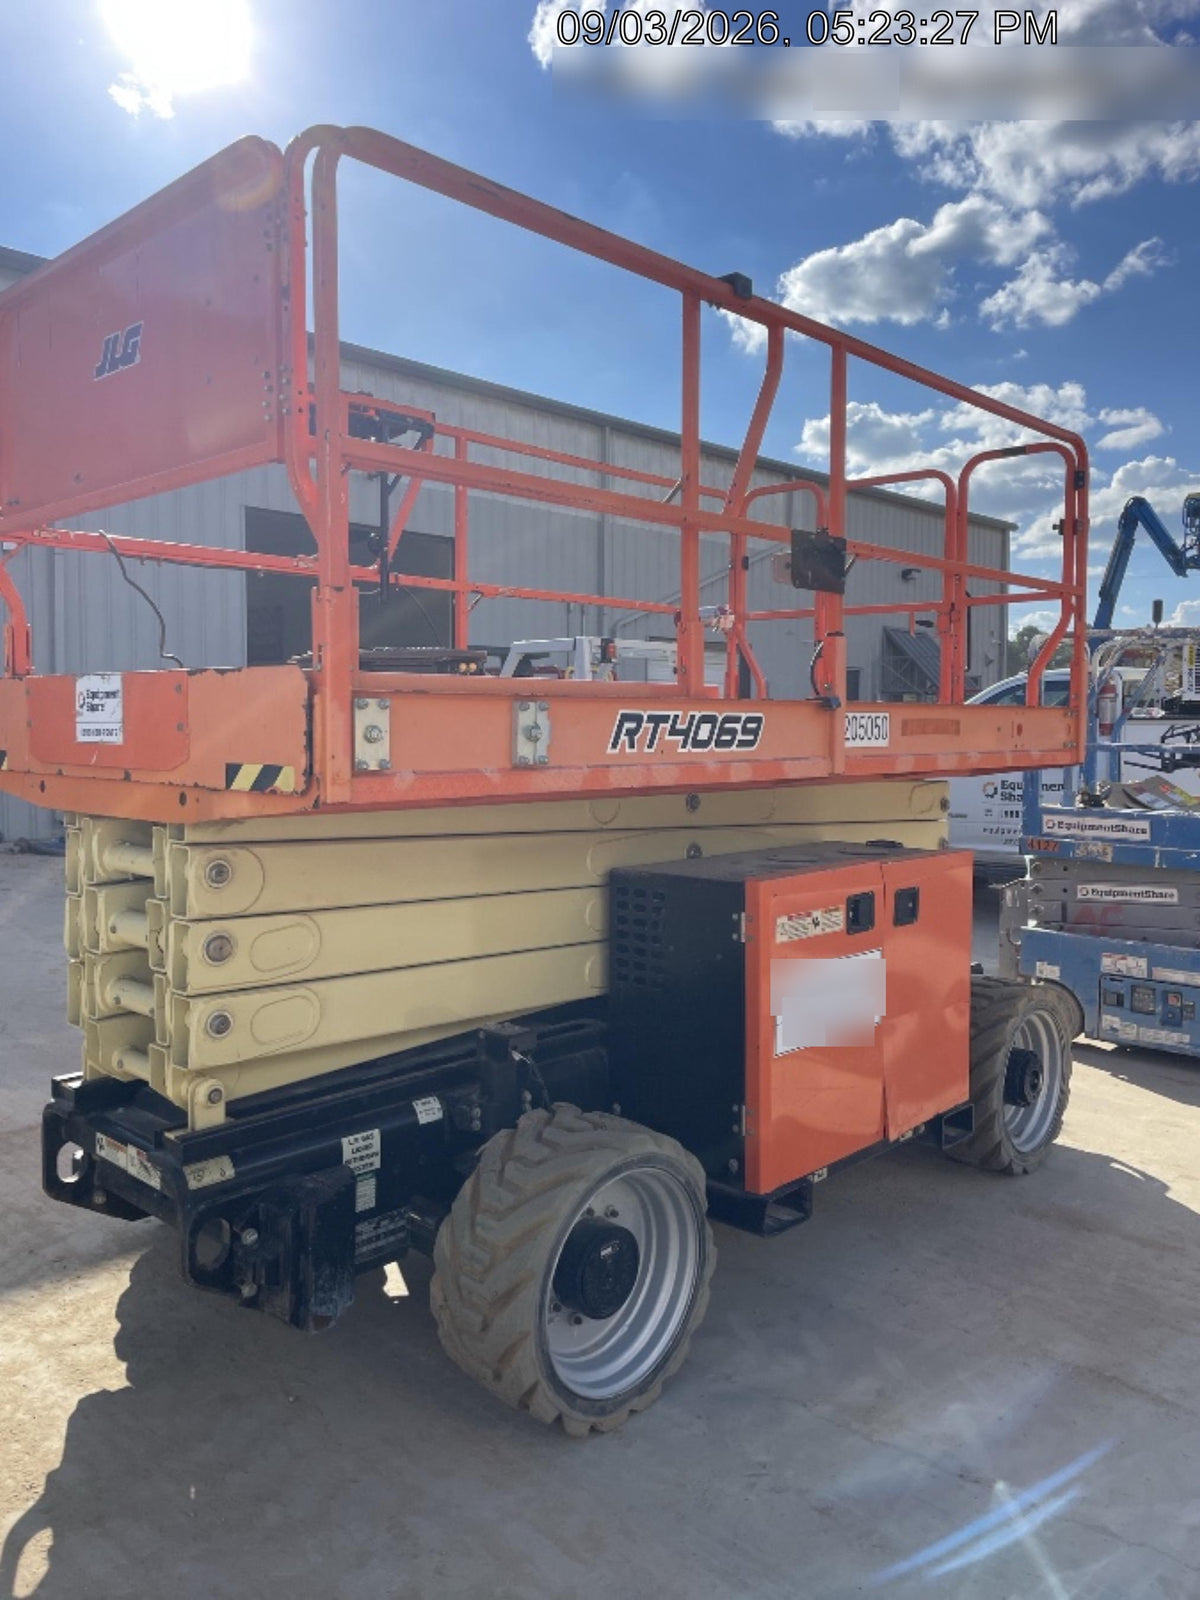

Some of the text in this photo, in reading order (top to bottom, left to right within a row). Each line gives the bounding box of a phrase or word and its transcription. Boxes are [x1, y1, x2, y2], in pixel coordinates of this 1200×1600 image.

[93, 320, 144, 381] JLG
[606, 710, 765, 754] RT4069
[1057, 820, 1148, 835] EquipmentShare
[1090, 887, 1175, 899] EquipmentShare
